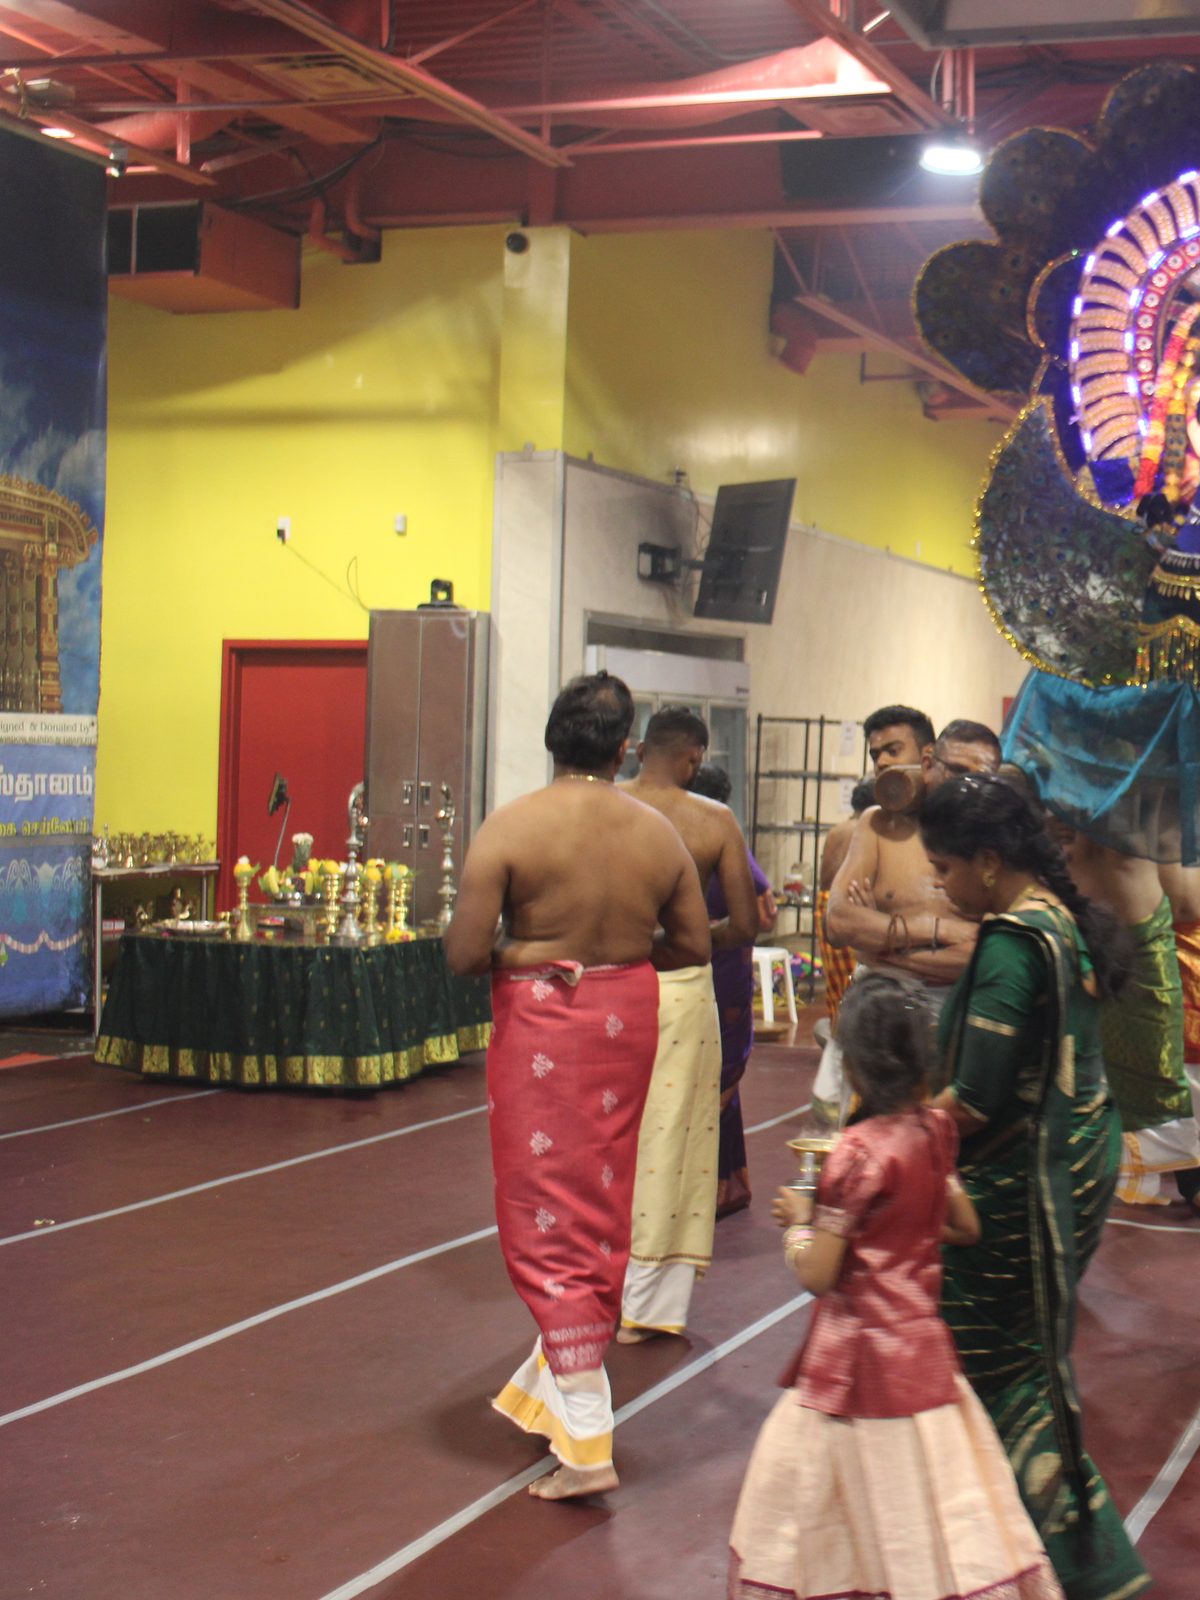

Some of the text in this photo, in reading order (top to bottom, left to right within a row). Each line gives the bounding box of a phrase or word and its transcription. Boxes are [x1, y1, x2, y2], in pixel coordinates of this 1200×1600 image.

[30, 721, 37, 732] &
[40, 721, 78, 732] Donated
[80, 722, 90, 735] by
